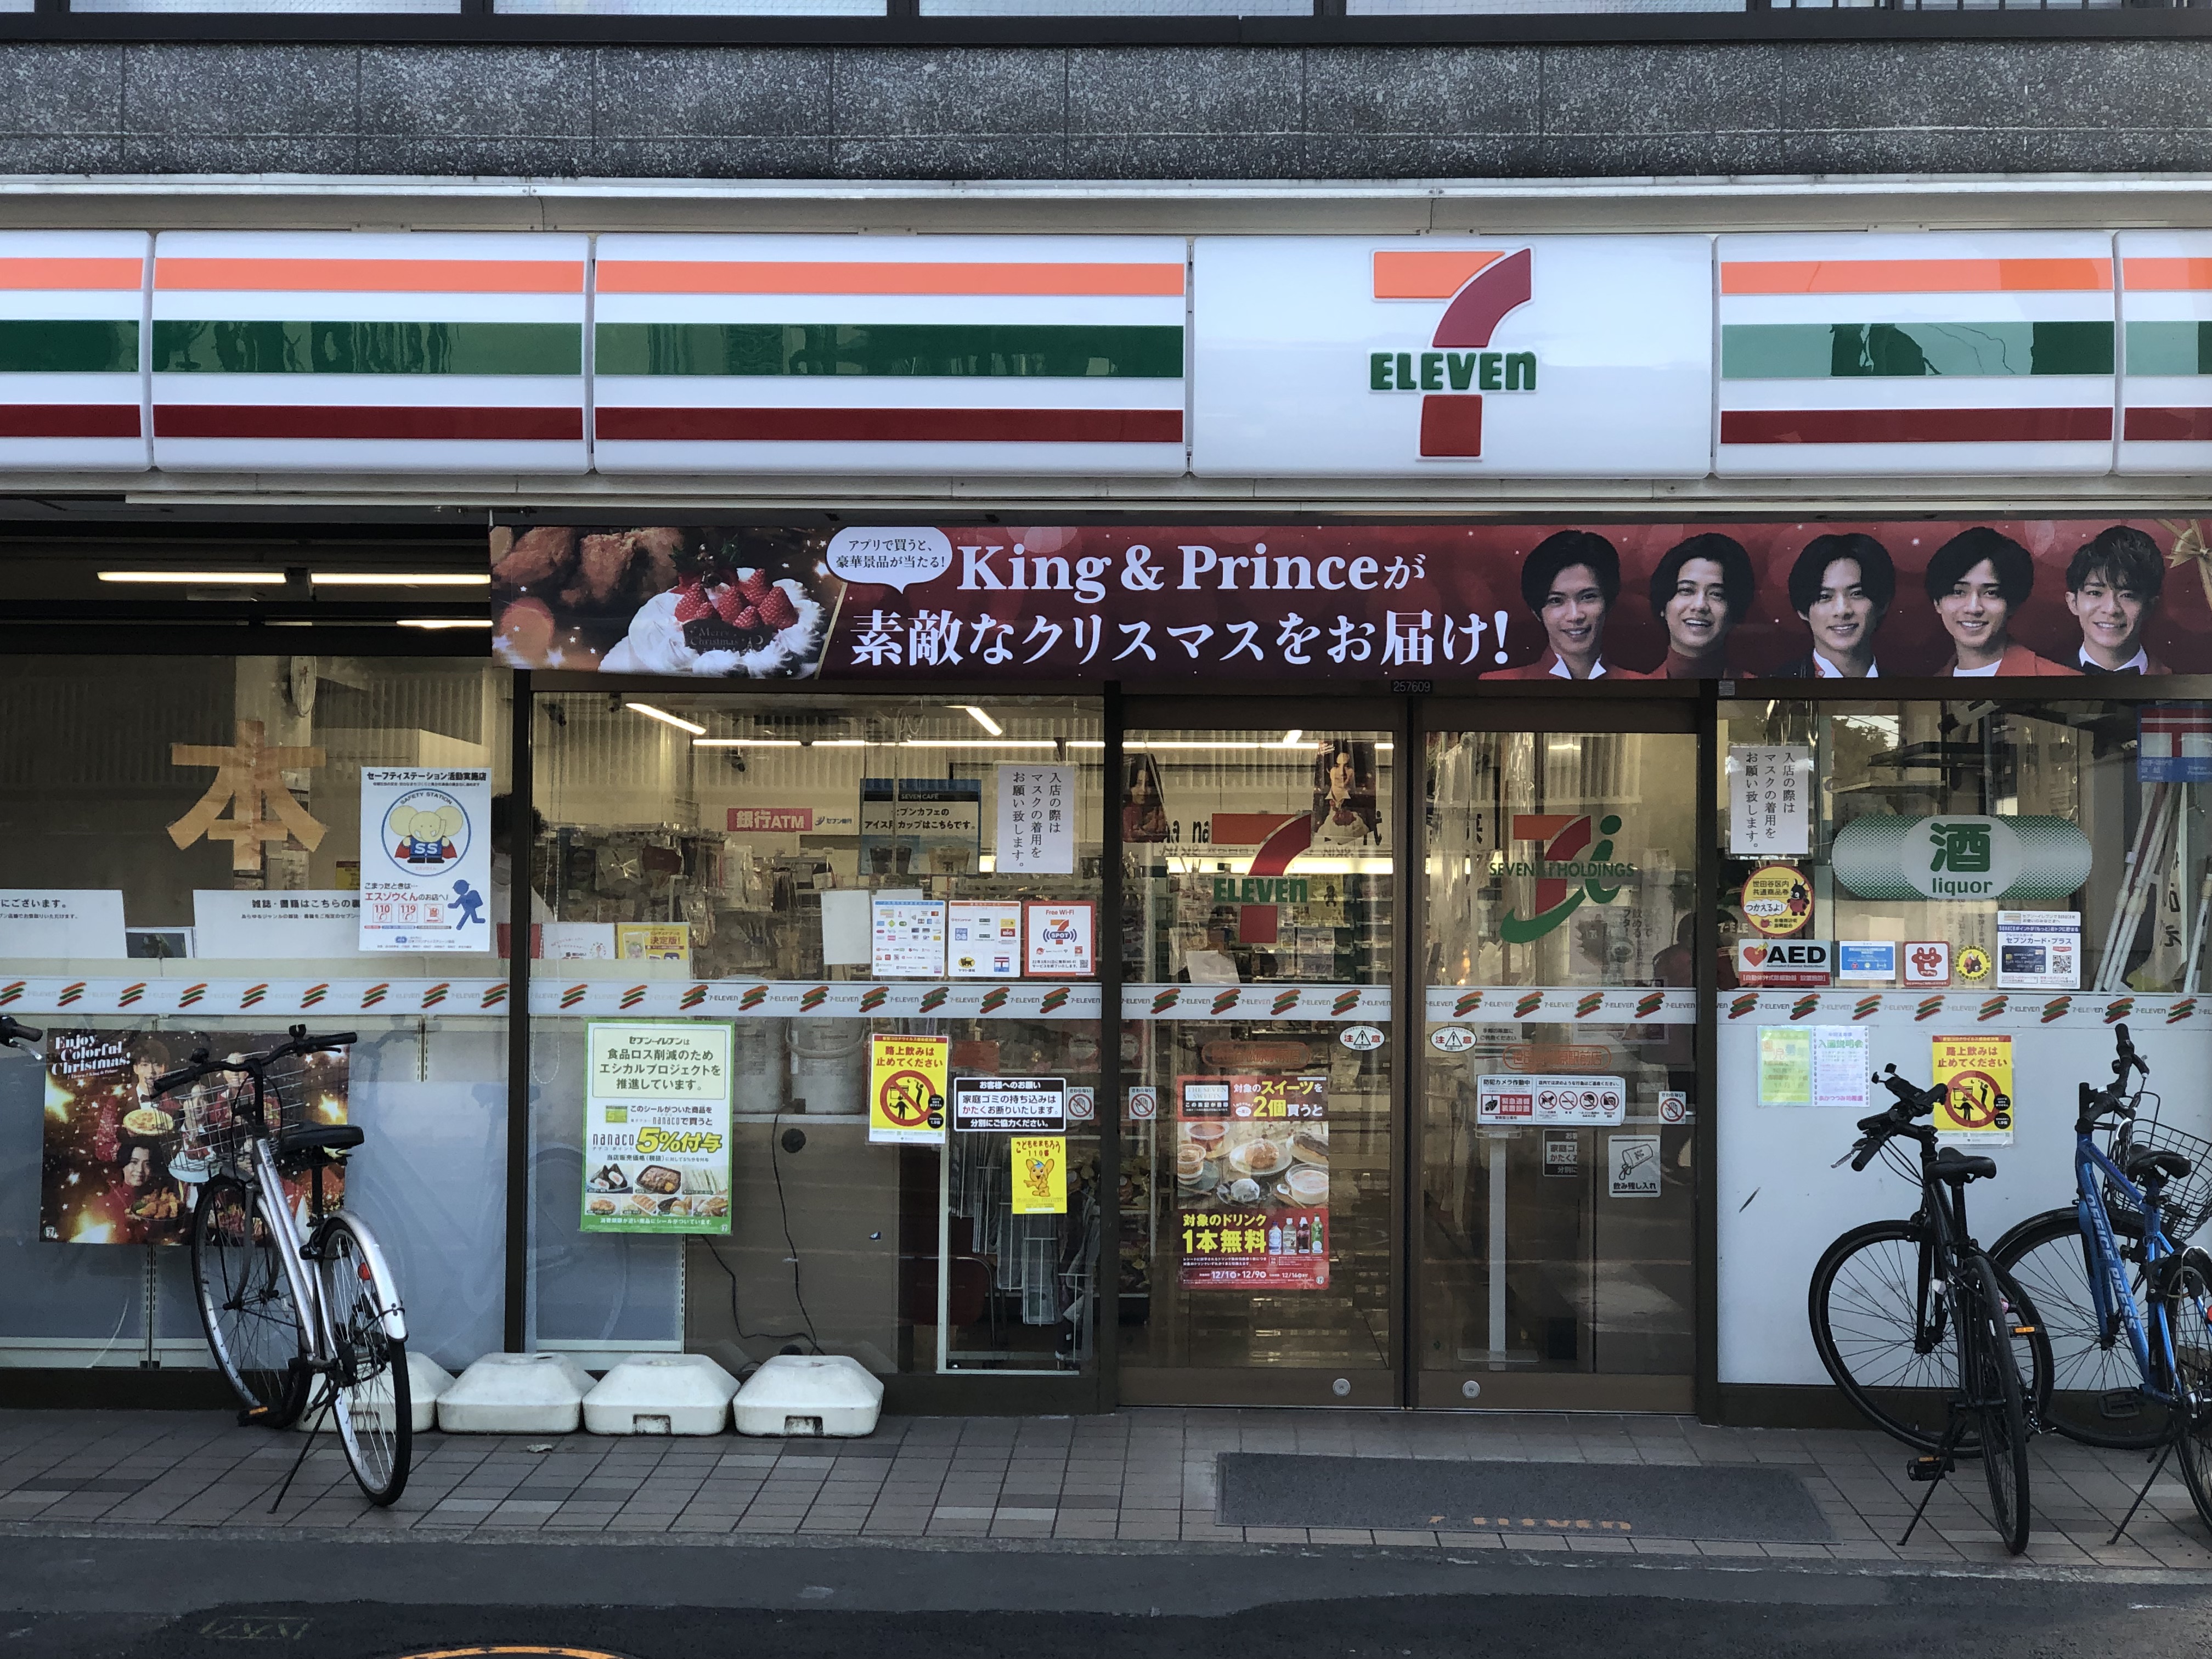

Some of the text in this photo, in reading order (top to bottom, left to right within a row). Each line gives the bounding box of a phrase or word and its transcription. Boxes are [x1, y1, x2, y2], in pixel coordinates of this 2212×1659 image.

[848, 539, 934, 552] アプリで買うと、
[836, 555, 946, 570] 豪華景品が当たる!
[957, 544, 1111, 602] King
[1125, 546, 1164, 591] &
[691, 636, 738, 646] Christmas
[849, 609, 1510, 667] 素敵なクリスマスをお届け!
[1393, 681, 1431, 692] 257609
[1783, 752, 1796, 813] 入店の際は
[166, 720, 328, 870] 本
[400, 792, 453, 805] SAFETY STATION
[1746, 752, 1758, 848] お願い致します。
[1764, 754, 1776, 839] マスクの着用を
[1049, 772, 1062, 833] 入店の際は
[736, 810, 805, 828] 銀行ATM
[1012, 772, 1025, 867] お願い致します。
[1031, 773, 1043, 859] マスクの着用を
[414, 843, 438, 854] SS
[1930, 823, 1991, 873] 酒
[1489, 862, 1535, 877] SEVEN
[1557, 862, 1634, 877] HOLDINGS
[1932, 877, 1993, 896] liquor
[1746, 903, 1783, 912] つかえるよ!
[1767, 946, 1826, 963] AED
[55, 1034, 96, 1049] Enjoy
[60, 1041, 122, 1061] Colorful
[607, 1048, 713, 1061] 食品ロス削減のため
[885, 1046, 935, 1056] 路上飲みは
[1946, 1046, 1998, 1056] 路上飲みは
[52, 1052, 131, 1075] Christmas!
[600, 1063, 721, 1076] エシカルプロジェクトを
[876, 1057, 944, 1068] 止めてください
[1937, 1058, 2008, 1068] 止めてください
[616, 1079, 702, 1091] 推進しています。
[979, 1081, 1041, 1089] お客様へのお願い
[962, 1095, 1057, 1104] 家庭ゴミの持ち込みは
[630, 1105, 713, 1114] このシールがついた商品を
[962, 1105, 1058, 1115] かたくお断りいたします。
[970, 1119, 1049, 1127] 分別にご協力ください。
[592, 1133, 634, 1146] nanaco
[1182, 1214, 1267, 1227] 対象のドリンク
[1182, 1228, 1267, 1254] 1本無料
[2085, 1193, 2137, 1329] OFFICE PRESS
